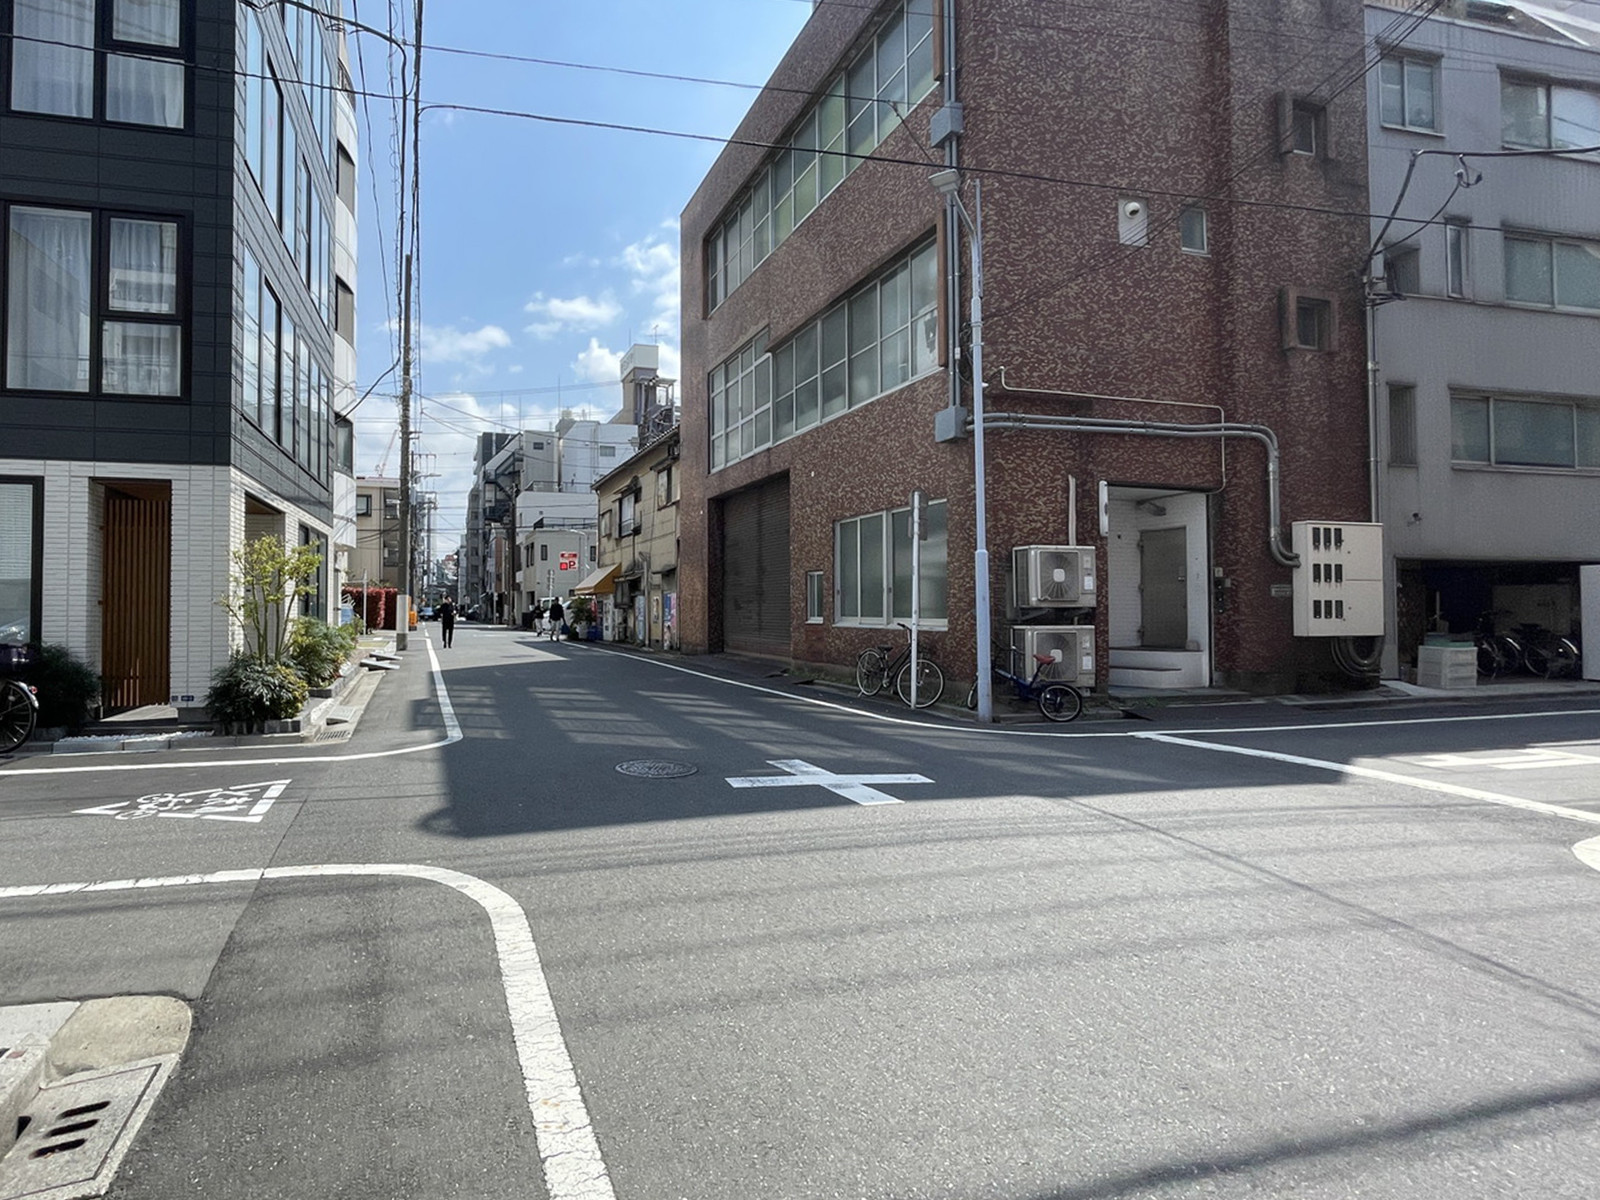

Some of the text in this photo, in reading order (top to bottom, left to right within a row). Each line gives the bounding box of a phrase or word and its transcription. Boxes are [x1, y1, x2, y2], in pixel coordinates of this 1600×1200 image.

[568, 560, 576, 569] P
[193, 789, 261, 813] とまれ
